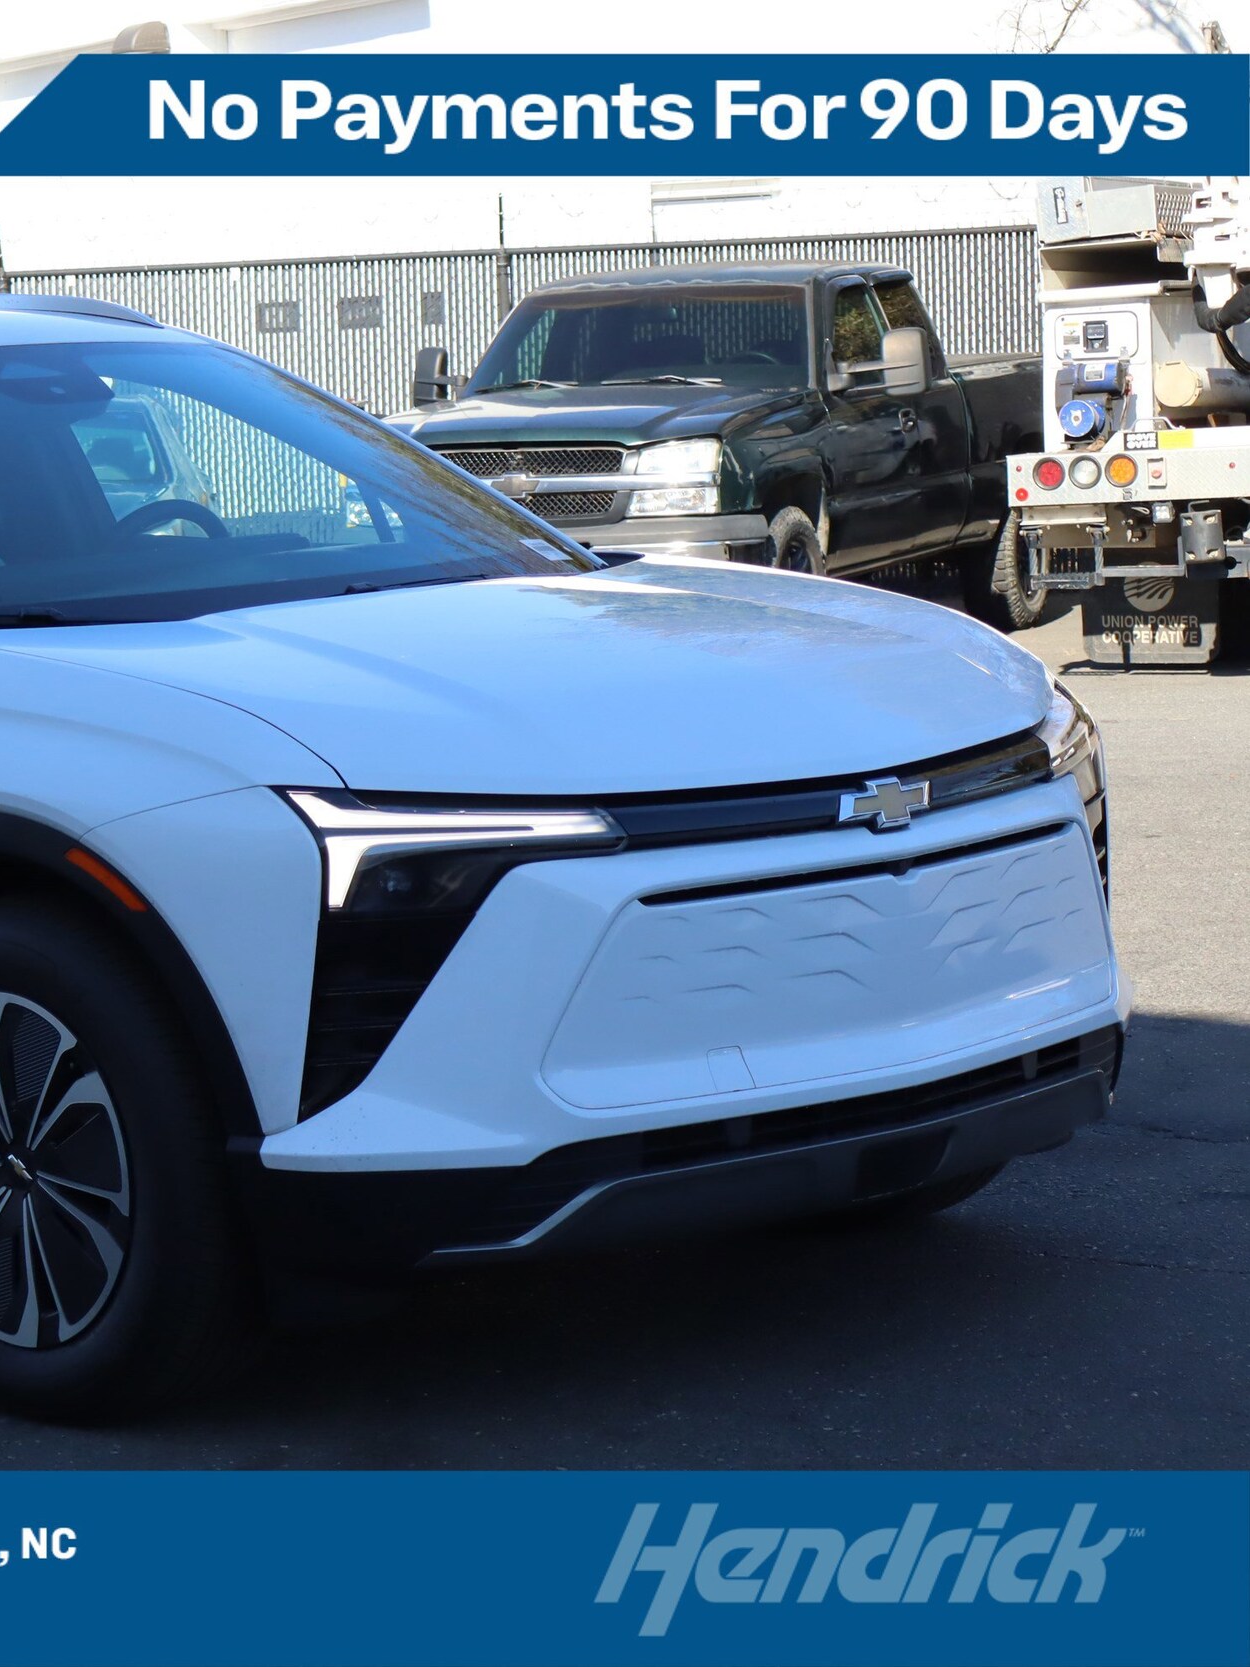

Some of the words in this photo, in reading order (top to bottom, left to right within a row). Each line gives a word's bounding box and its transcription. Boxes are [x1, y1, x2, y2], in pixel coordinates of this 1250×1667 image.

[1101, 615, 1144, 628] UNION
[1147, 615, 1198, 628] POWER
[1101, 630, 1199, 644] COOPERATIVE
